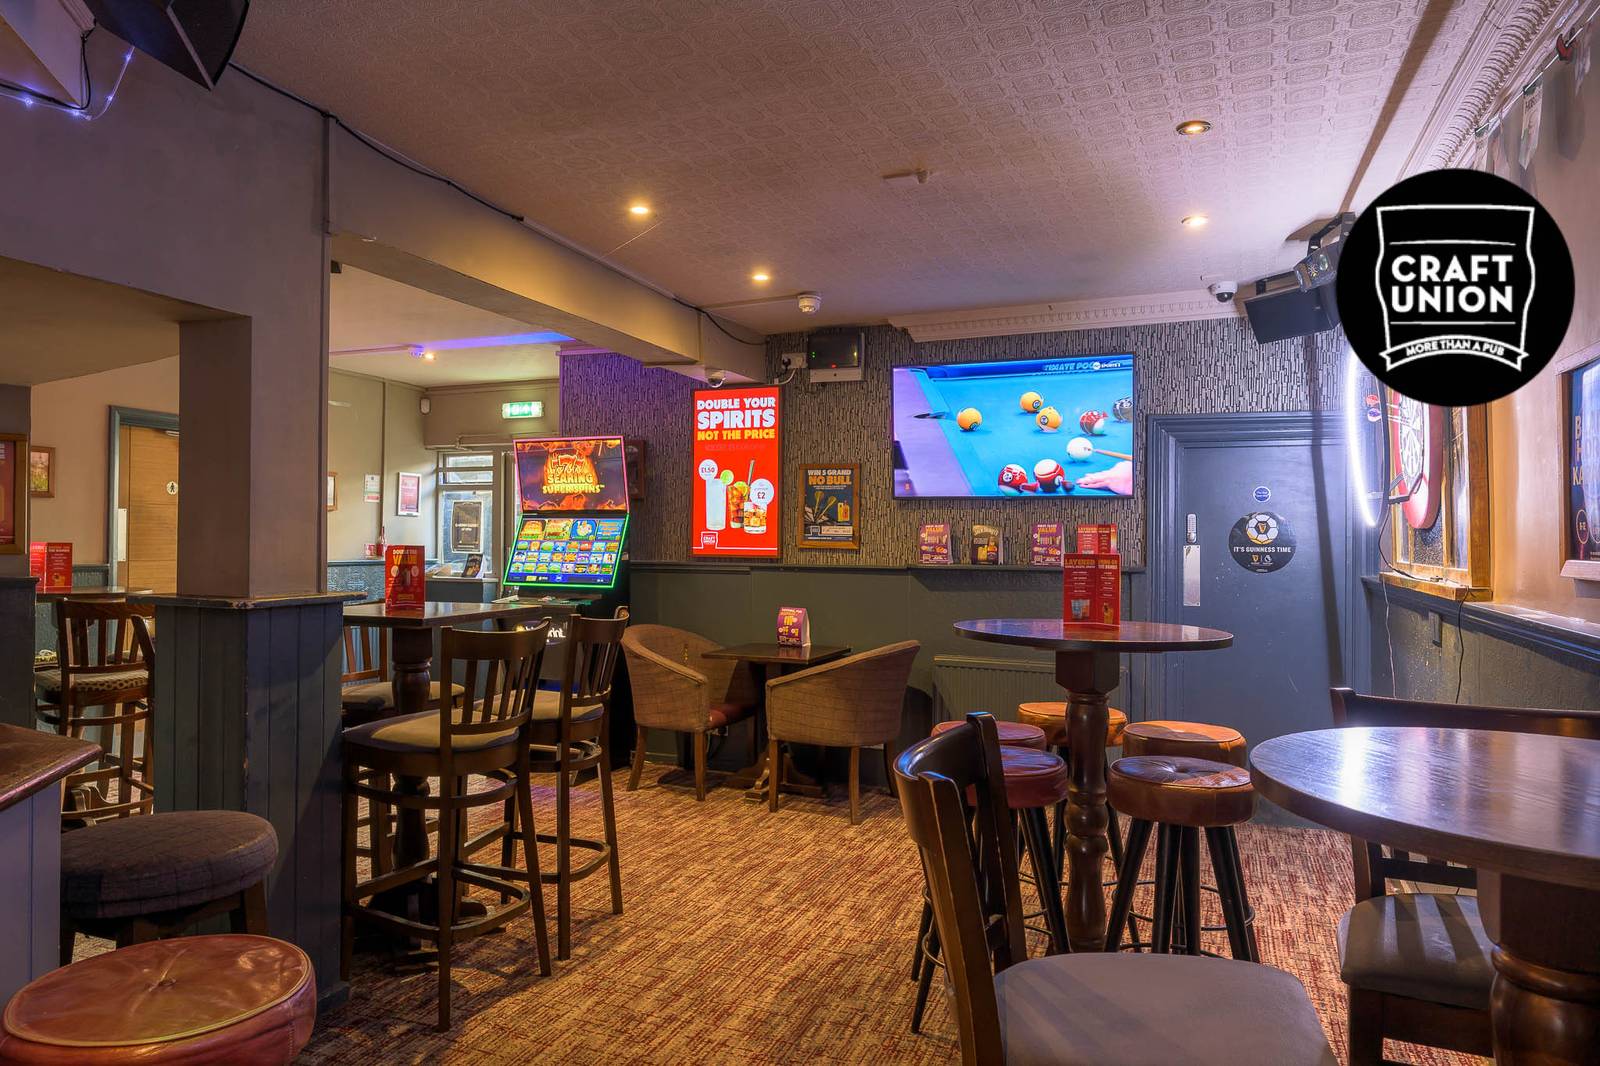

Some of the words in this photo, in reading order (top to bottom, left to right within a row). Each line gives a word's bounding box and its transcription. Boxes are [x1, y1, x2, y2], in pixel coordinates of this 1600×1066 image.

[697, 399, 740, 410] DOUBLE
[743, 397, 776, 408] YOUR
[697, 408, 776, 430] SPIRITS
[697, 430, 719, 440] NOT
[722, 429, 741, 440] THE
[744, 428, 775, 439] PRICE
[548, 473, 594, 484] SEARING
[808, 475, 825, 485] NO
[826, 475, 852, 485] BULL
[757, 492, 766, 500] £2
